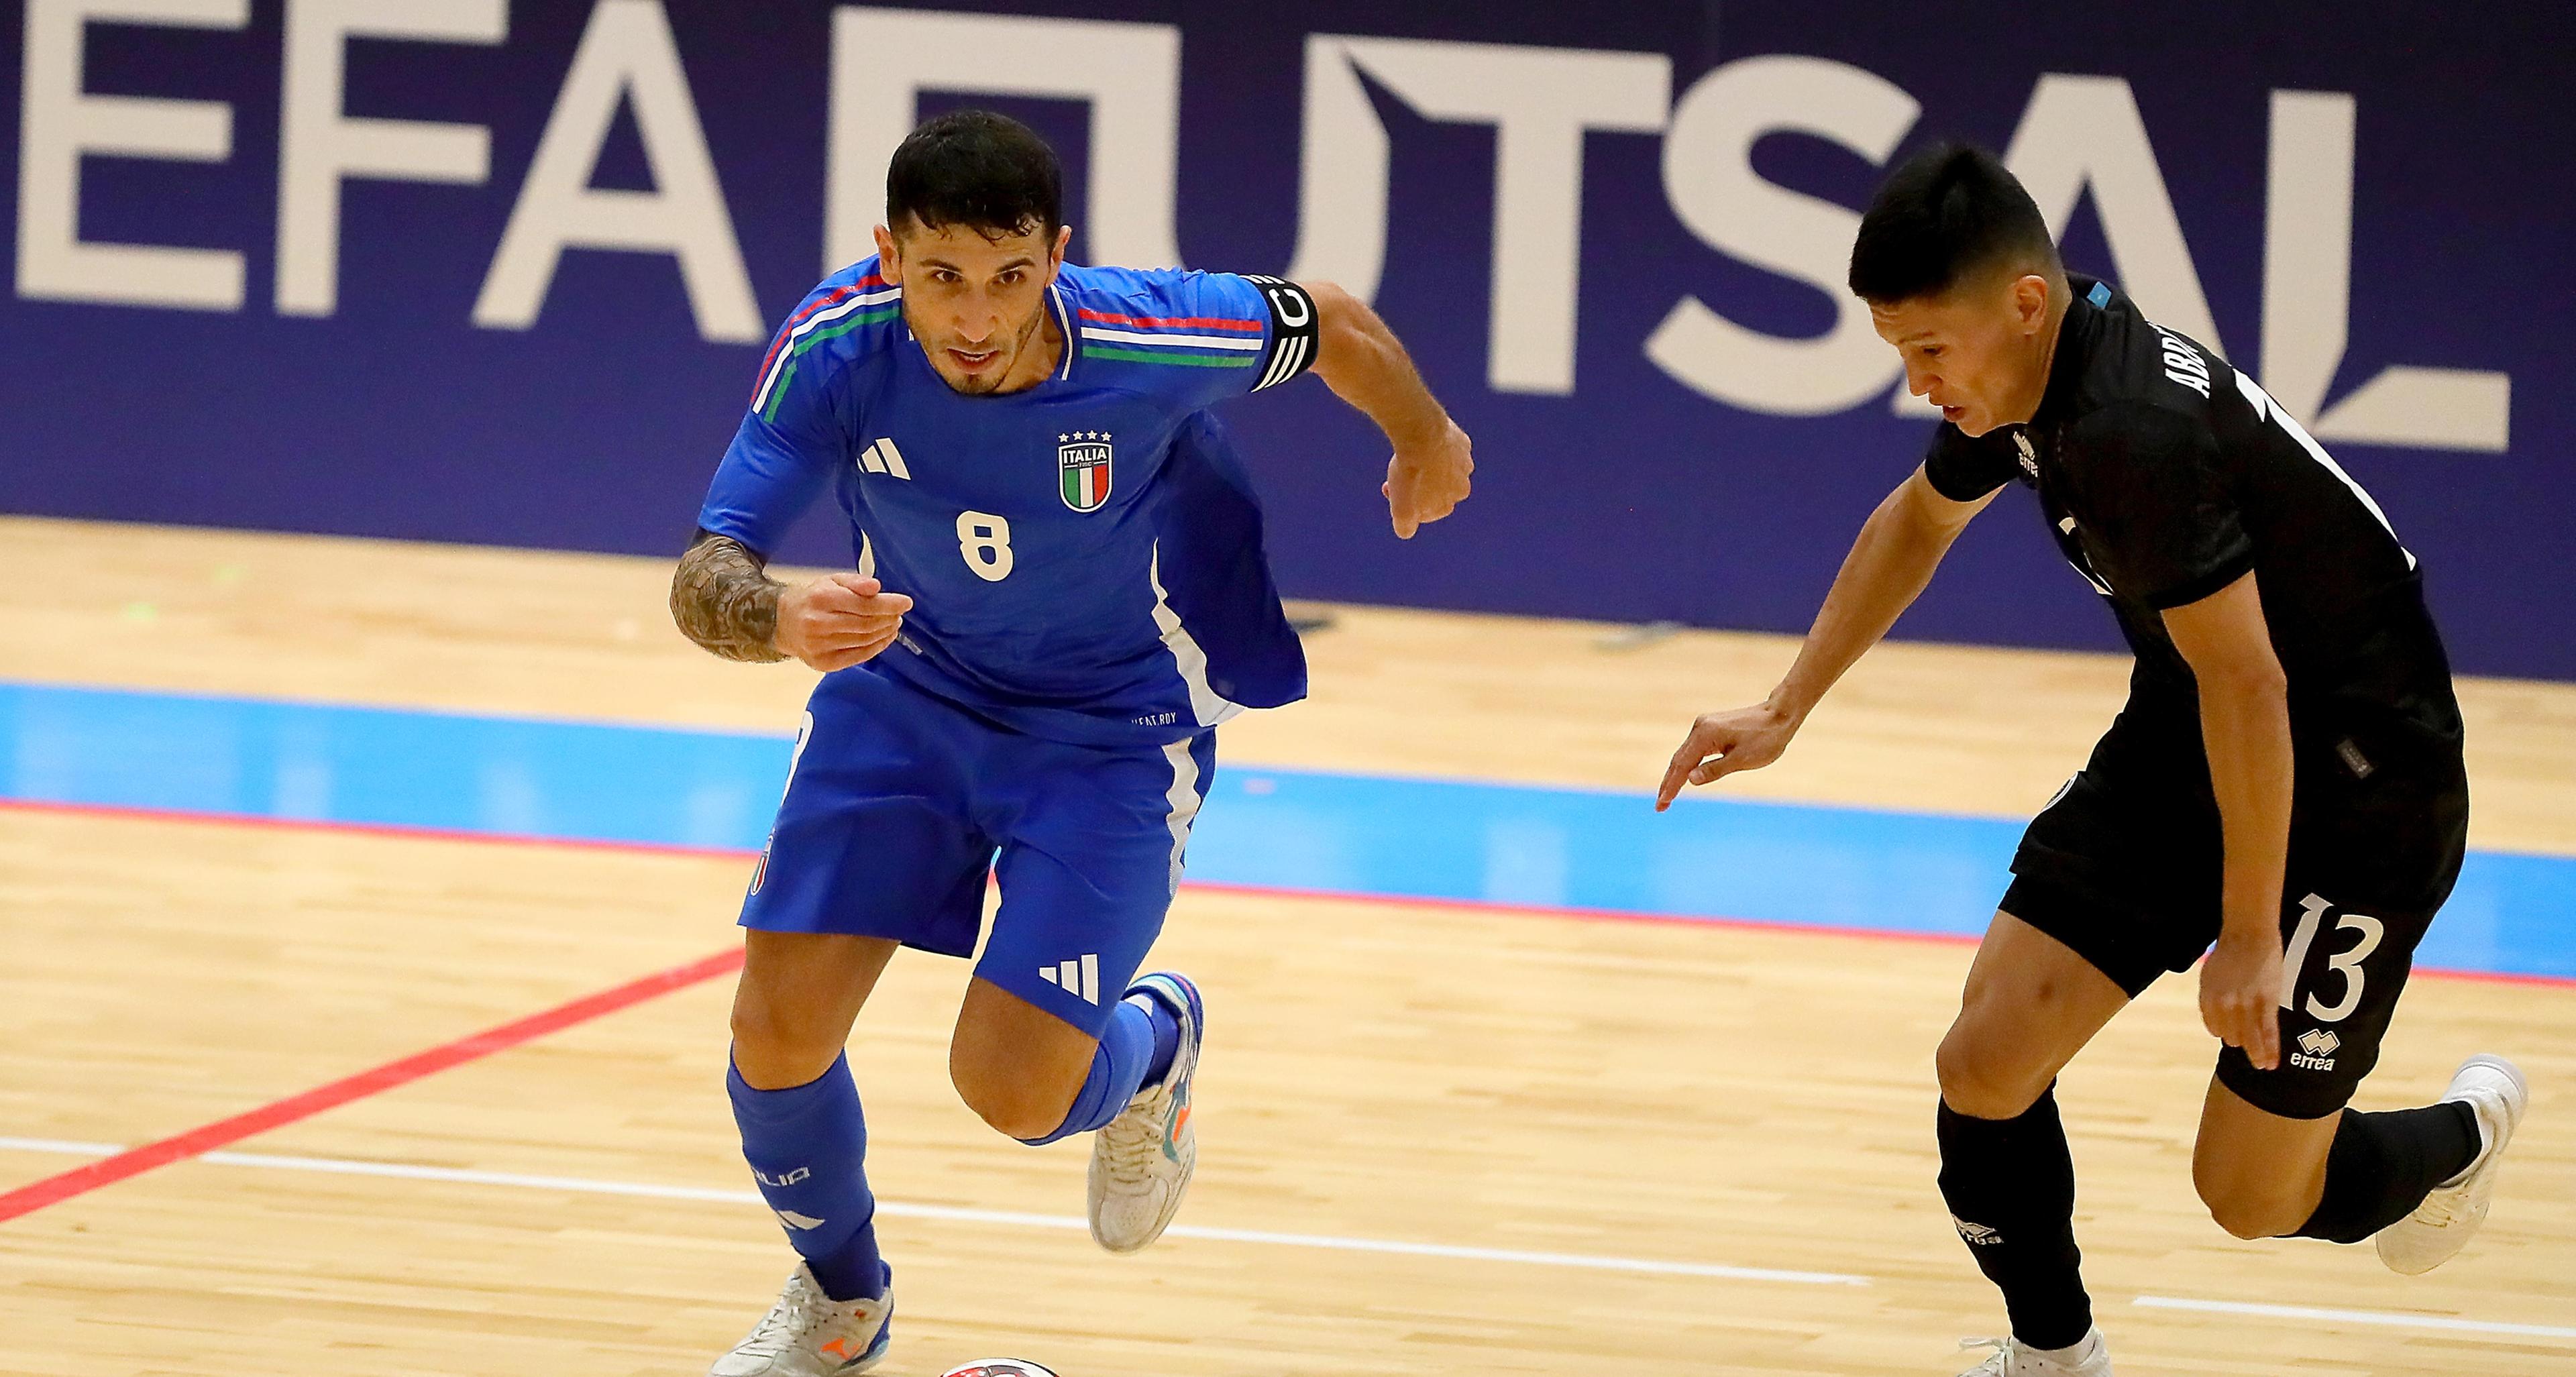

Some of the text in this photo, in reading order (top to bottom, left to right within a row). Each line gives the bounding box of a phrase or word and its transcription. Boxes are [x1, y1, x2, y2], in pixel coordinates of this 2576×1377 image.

[13, 0, 767, 344] EFA
[1268, 288, 1309, 328] C
[2147, 321, 2210, 400] ABD
[1063, 447, 1108, 464] ITALIA
[956, 510, 1014, 582] 8
[2279, 892, 2384, 1022] 13
[2290, 1052, 2335, 1072] errea
